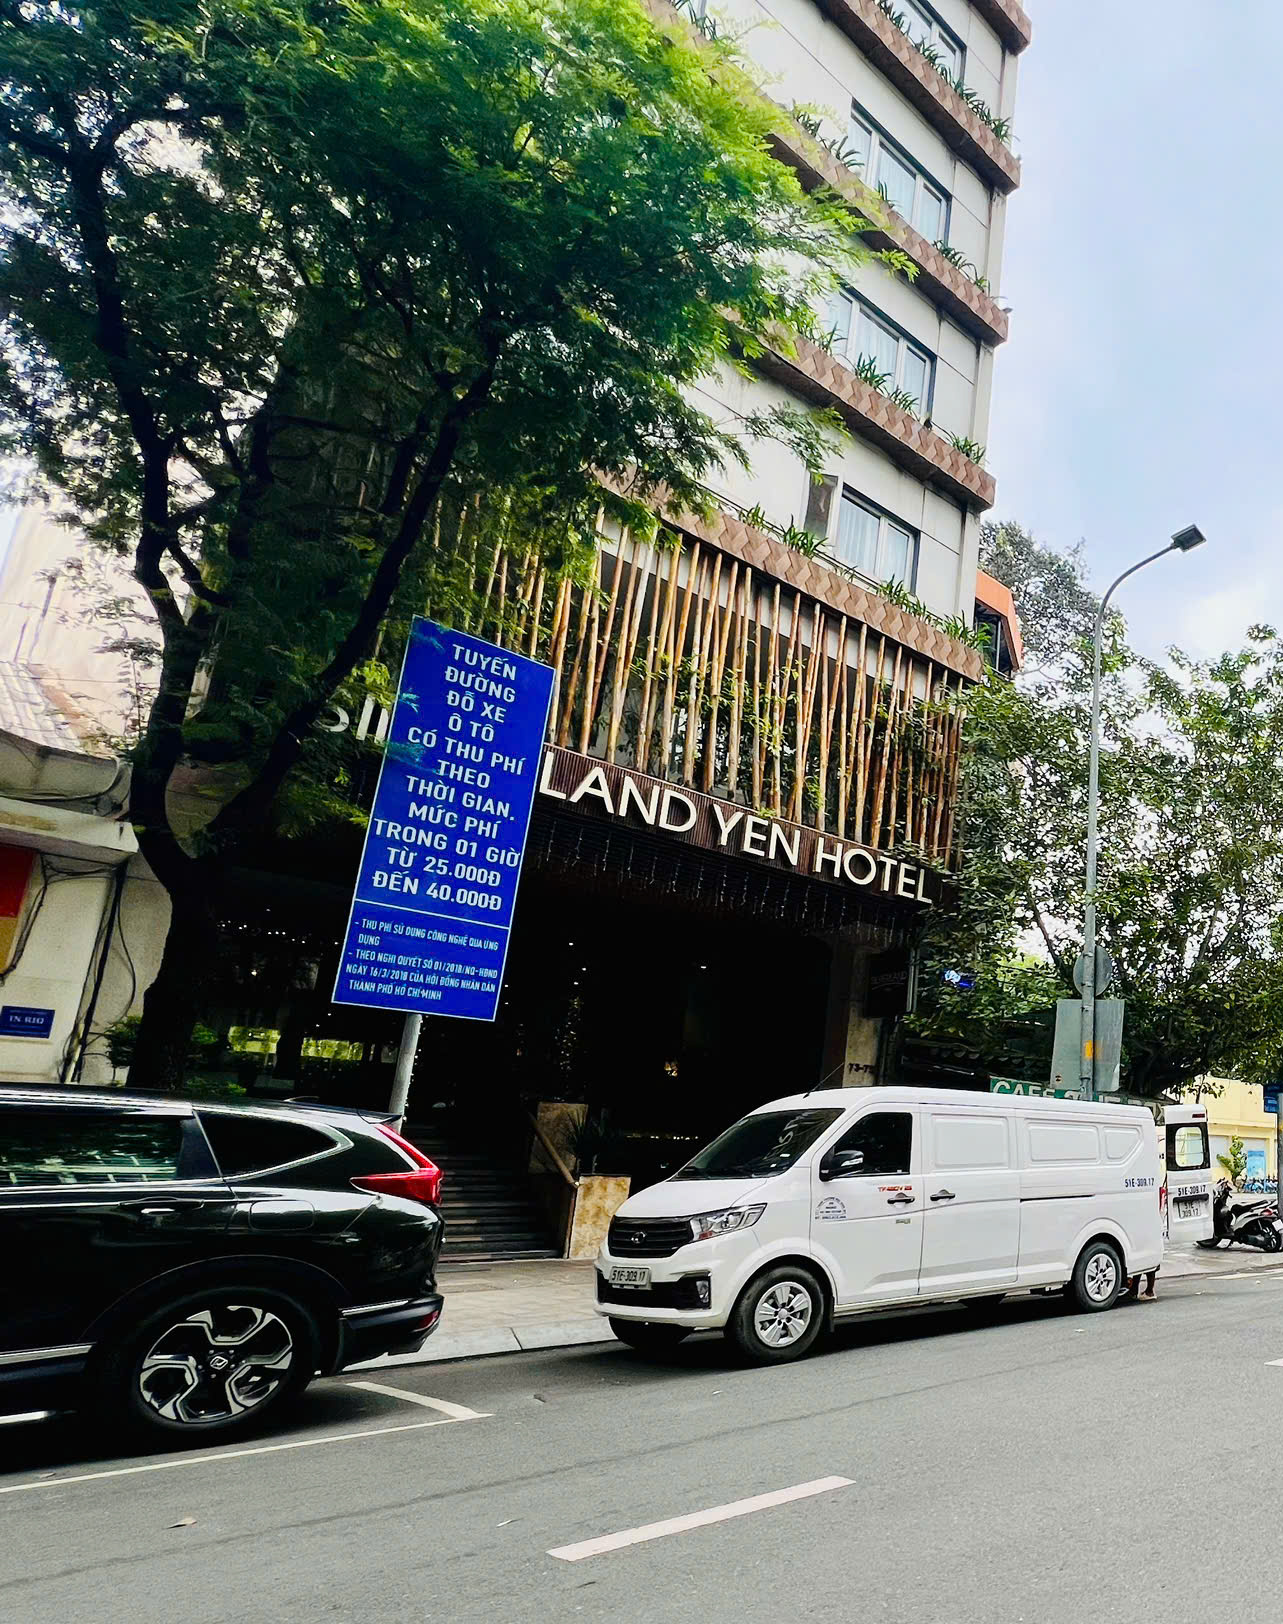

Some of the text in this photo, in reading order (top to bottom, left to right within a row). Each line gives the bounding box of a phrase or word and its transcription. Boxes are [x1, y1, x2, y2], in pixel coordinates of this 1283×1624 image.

[452, 643, 517, 681] TUYẾN
[444, 666, 516, 703] ĐƯỜNG
[446, 690, 507, 723] ĐỖ XE
[448, 712, 495, 742] Ô TÔ
[407, 726, 527, 775] CÓ THU PHÍ
[406, 775, 456, 803] THỜI
[437, 759, 490, 789] THEO
[408, 801, 502, 839] MỨC PHÍ
[538, 751, 698, 833] LAND
[712, 803, 801, 866] YEN
[812, 836, 932, 904] HOTEL
[373, 818, 521, 868] TRONG 01 GIỜ
[386, 846, 501, 887] TỪ 25.000Đ
[372, 870, 502, 911] ĐẾN 40.000Đ
[362, 918, 378, 930] THU
[378, 920, 394, 932] PHÍ
[393, 922, 405, 935] SỬ
[469, 937, 483, 948] QUA
[356, 949, 376, 960] THEO
[345, 963, 368, 976] NGÀY
[370, 966, 408, 981] 16/3/2018
[409, 970, 424, 983] CỦA
[349, 979, 376, 993] THÀNH
[1124, 1177, 1155, 1188] 51E-309.17
[1177, 1184, 1206, 1196] 51E-309.17
